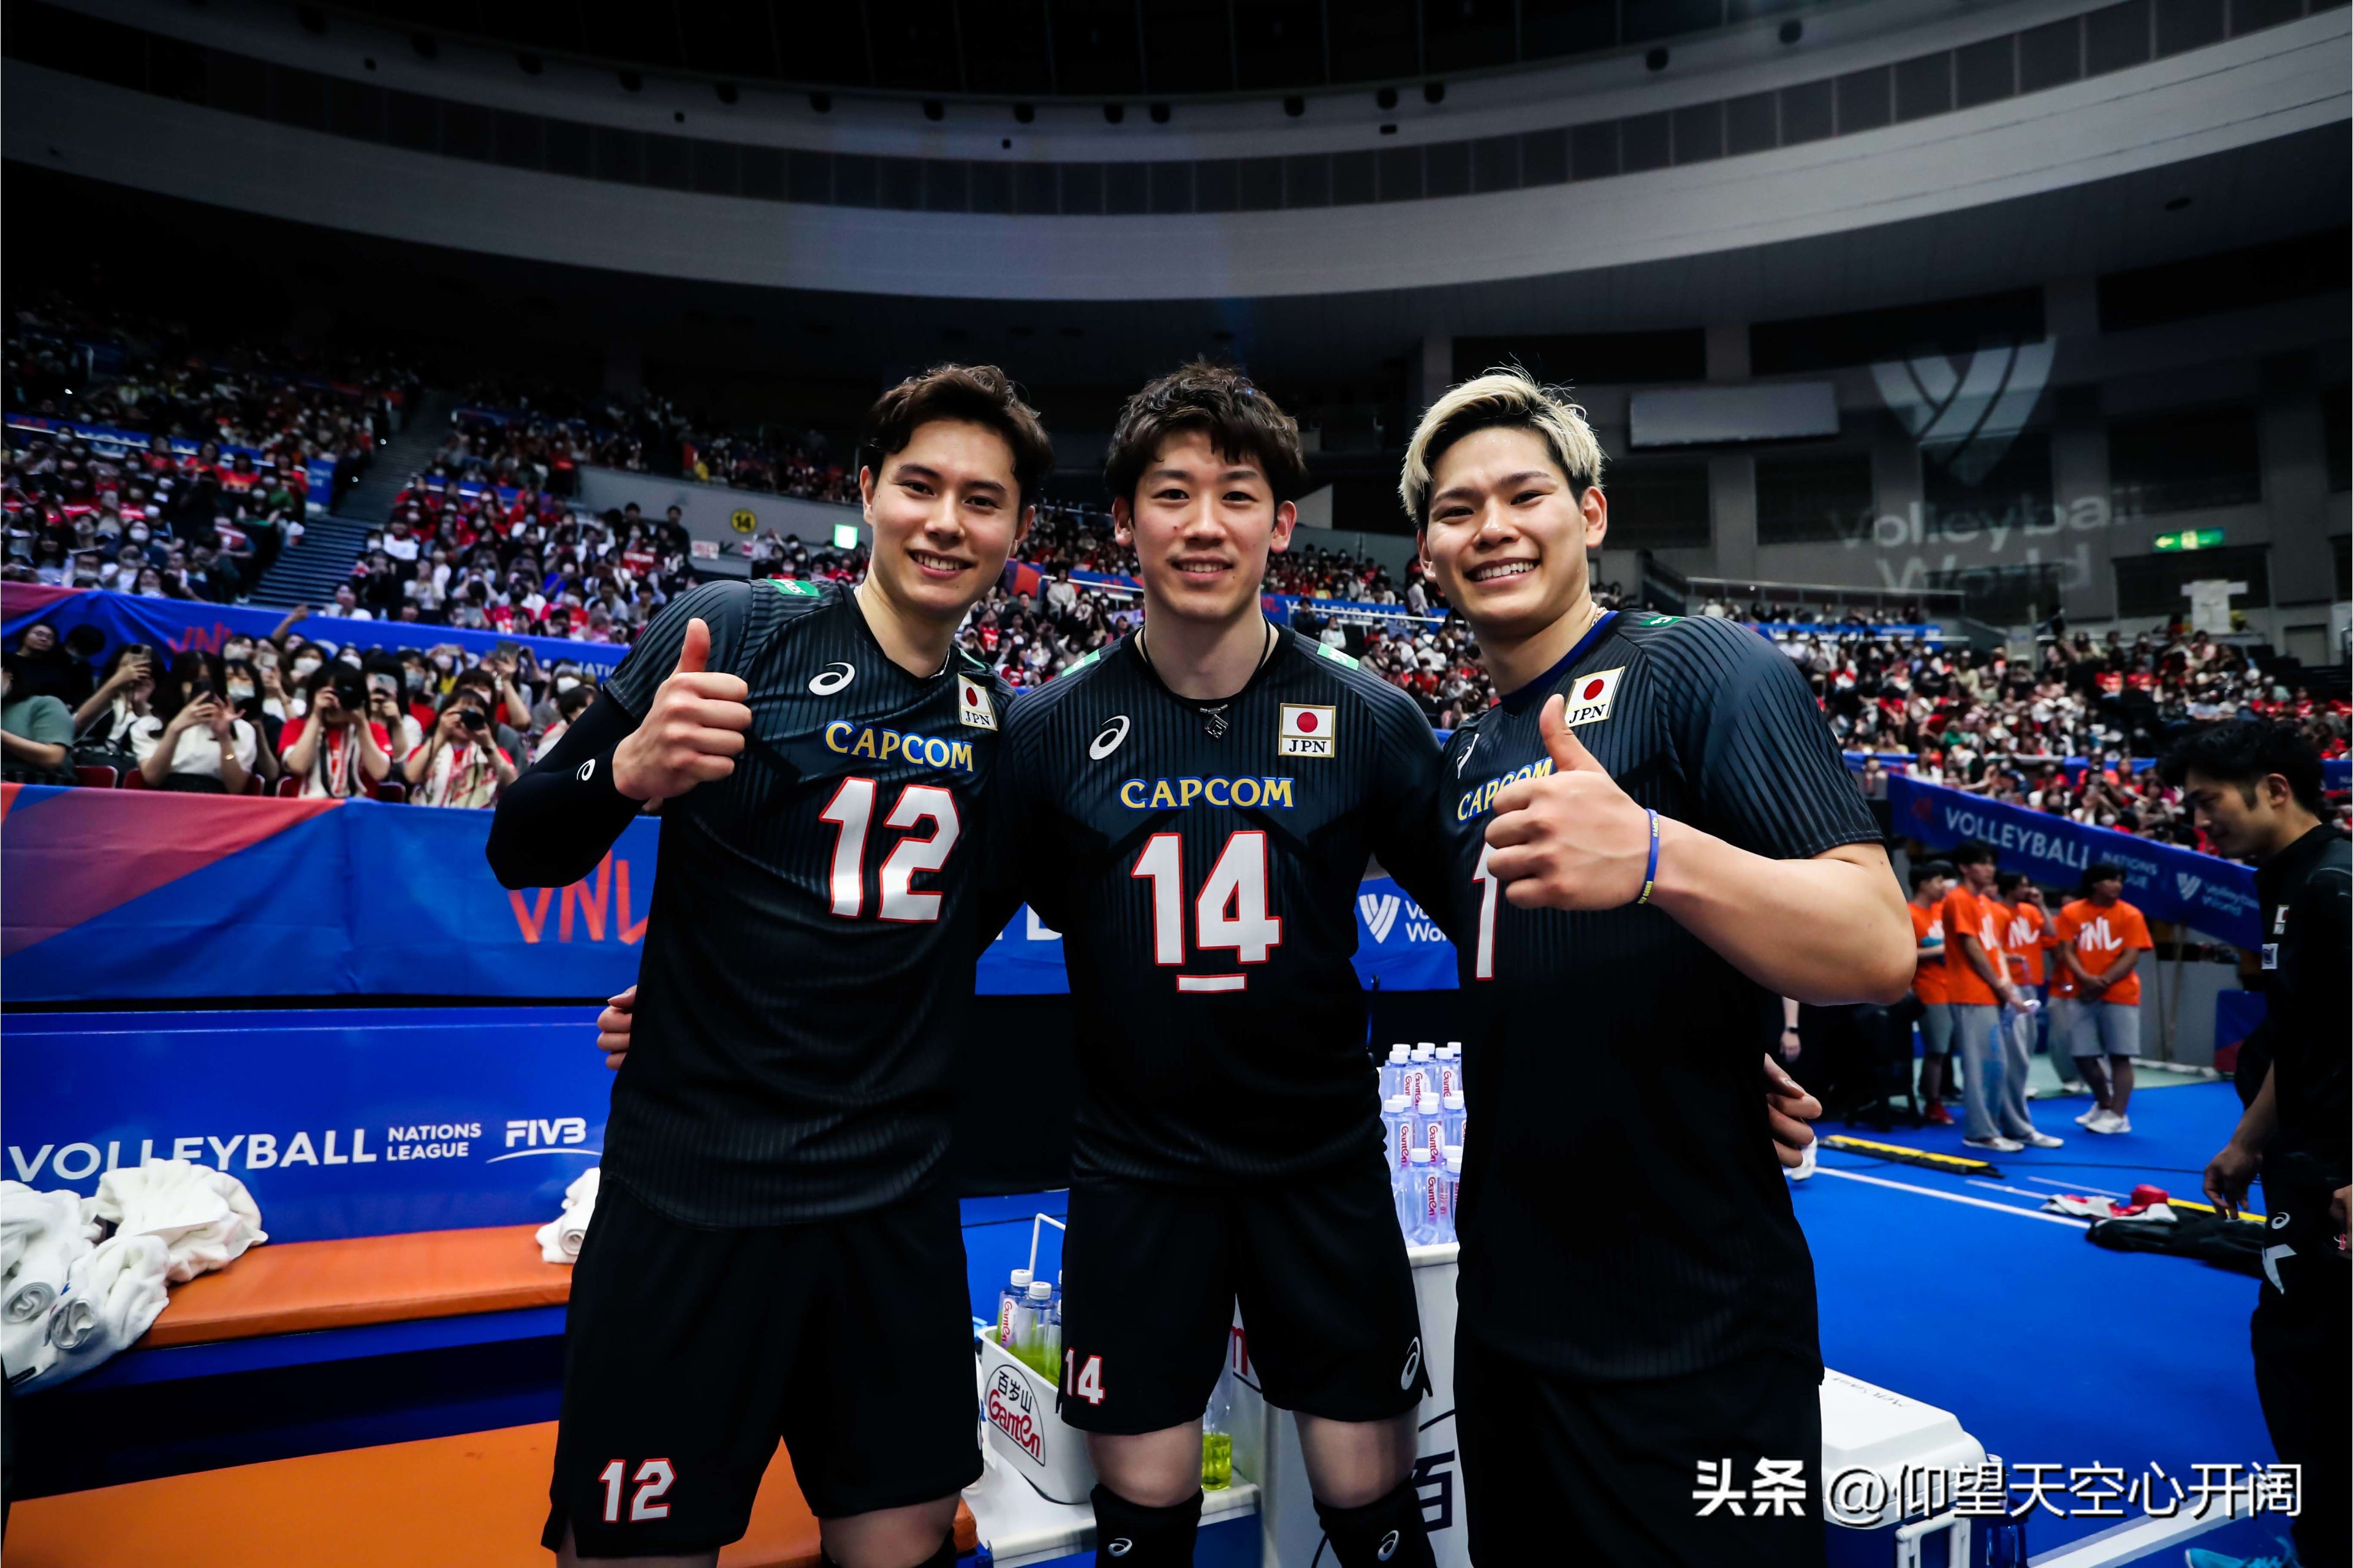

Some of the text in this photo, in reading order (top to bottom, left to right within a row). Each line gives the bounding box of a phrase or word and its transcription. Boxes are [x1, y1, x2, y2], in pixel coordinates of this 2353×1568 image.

[735, 515, 752, 529] 14
[167, 620, 232, 656] VN
[964, 710, 990, 726] JPN
[1569, 703, 1606, 724] JPN
[825, 721, 974, 773] CAPCOM
[1289, 740, 1327, 753] JPN
[1120, 776, 1295, 809] CAPCOM
[819, 776, 961, 923] 12
[508, 848, 648, 945] VNL
[1131, 830, 1283, 966] 14
[1472, 840, 1500, 981] 1
[387, 1142, 469, 1161] LEAGUE
[388, 1123, 482, 1142] NATIONS
[506, 1117, 586, 1148] FIVB
[998, 1370, 1033, 1414] 百岁山
[1064, 1347, 1105, 1406] 14
[598, 1458, 677, 1523] 12
